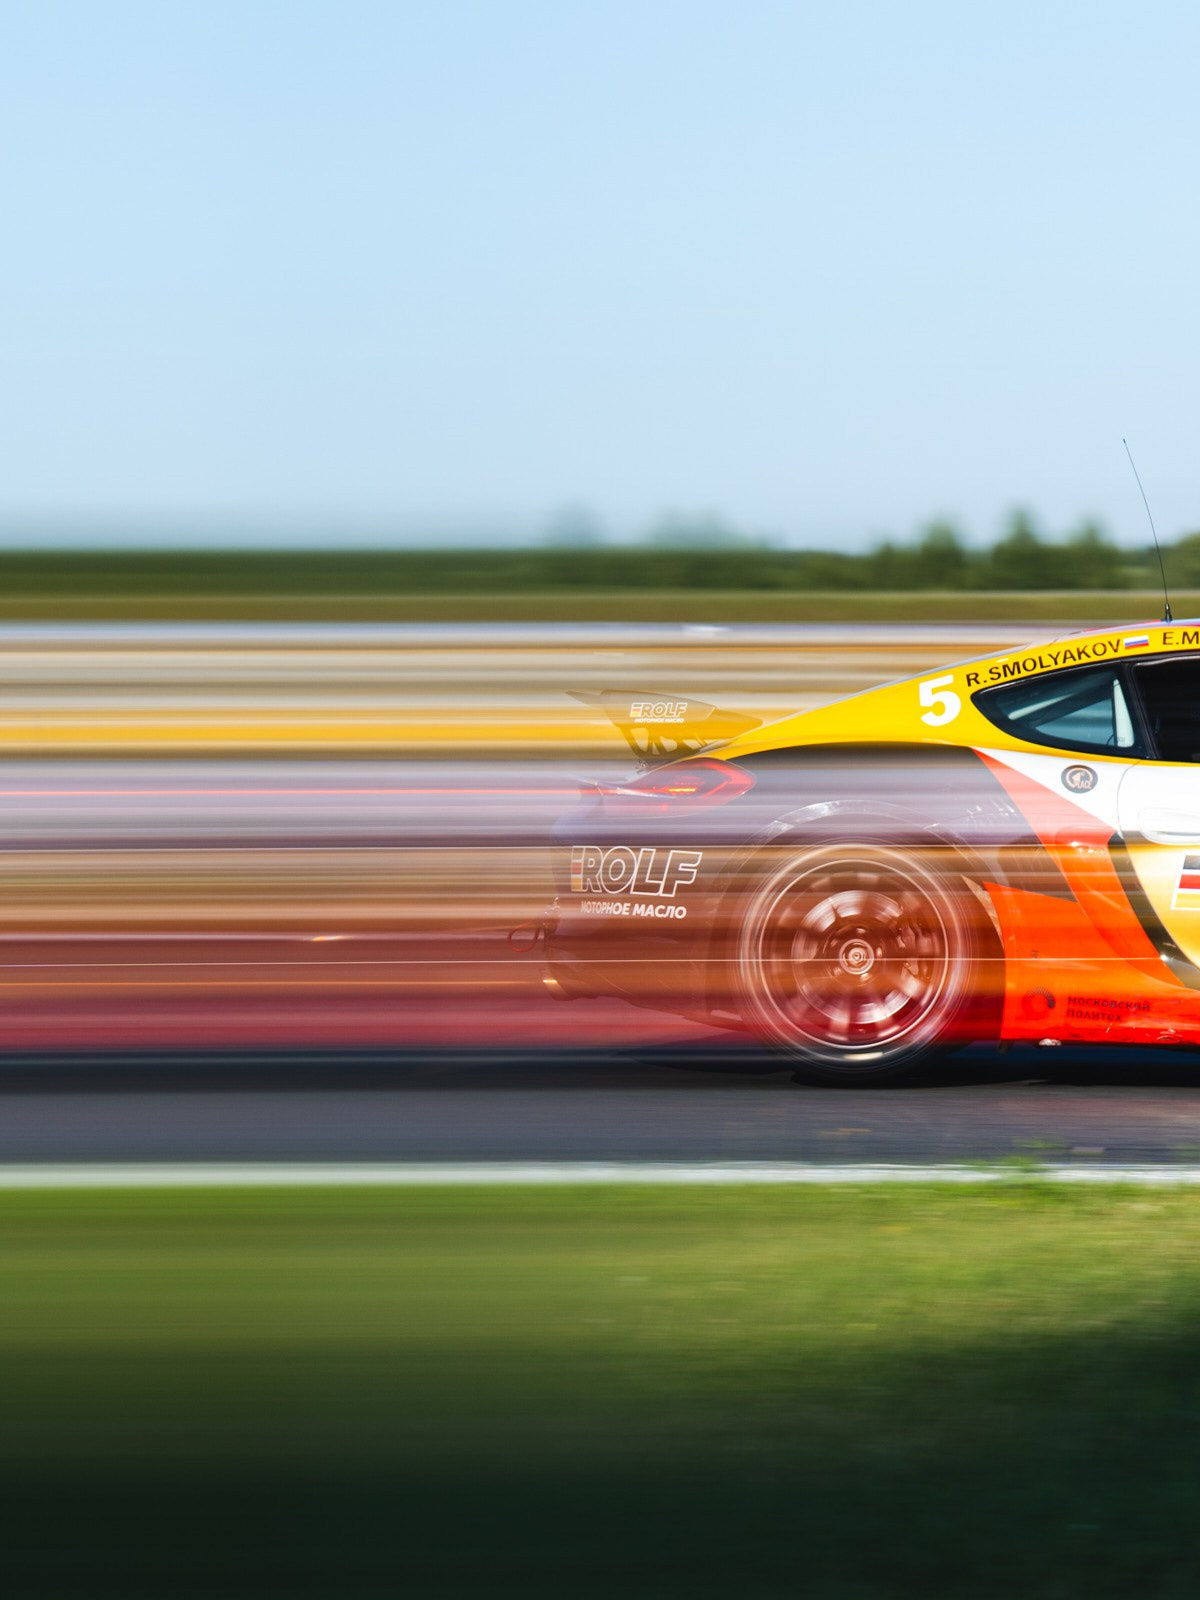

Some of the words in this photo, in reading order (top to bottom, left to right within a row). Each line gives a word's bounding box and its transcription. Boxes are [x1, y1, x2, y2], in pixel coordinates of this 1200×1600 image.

[965, 639, 1121, 687] R.SMOLYAKOV
[918, 674, 962, 727] 5
[632, 903, 688, 919] МАСЛО
